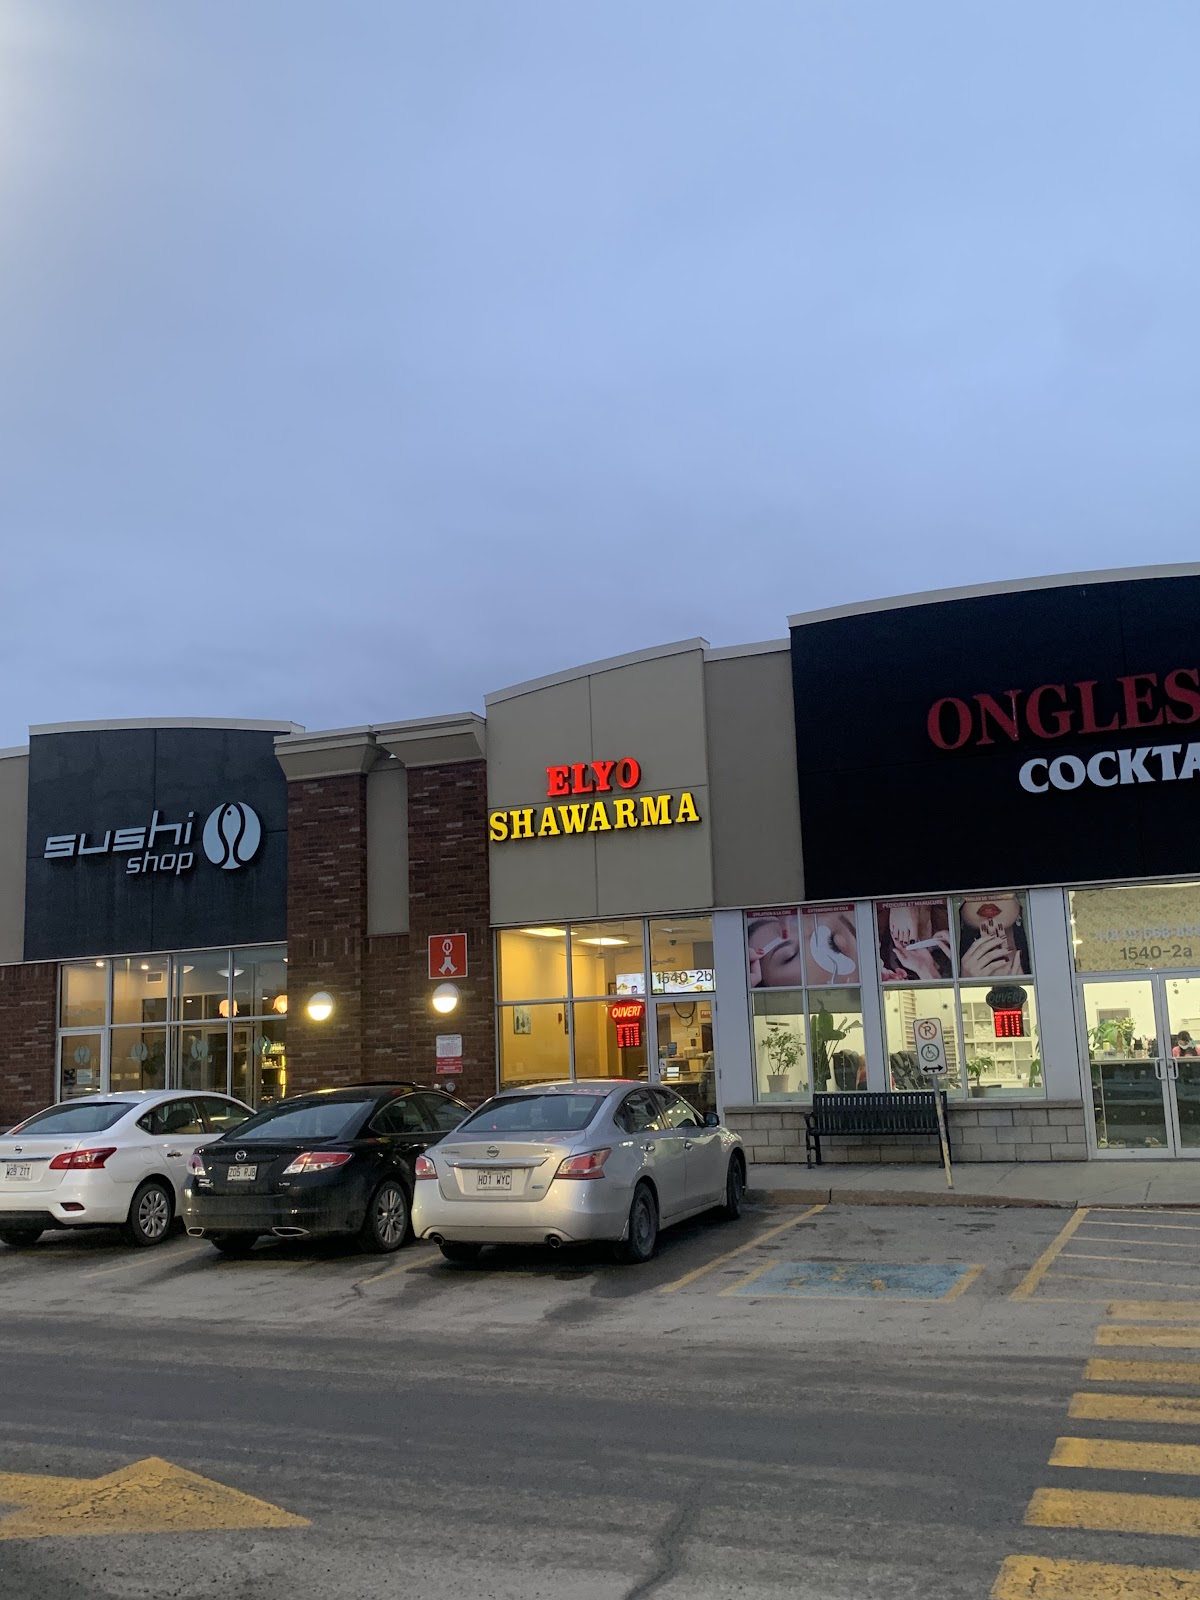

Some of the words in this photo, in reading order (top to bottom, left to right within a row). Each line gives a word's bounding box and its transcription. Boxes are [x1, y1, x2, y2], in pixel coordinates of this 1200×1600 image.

[927, 668, 1200, 750] ONGLES
[546, 757, 640, 796] ELYO
[489, 792, 700, 842] SHAWARMA
[43, 809, 195, 859] sushi
[125, 851, 194, 875] shop
[1120, 944, 1193, 961] 1540-2a
[656, 970, 713, 984] 1540-2b
[989, 991, 1023, 1003] OUVERT
[612, 1005, 642, 1018] OUVERT
[496, 1174, 510, 1185] WYC
